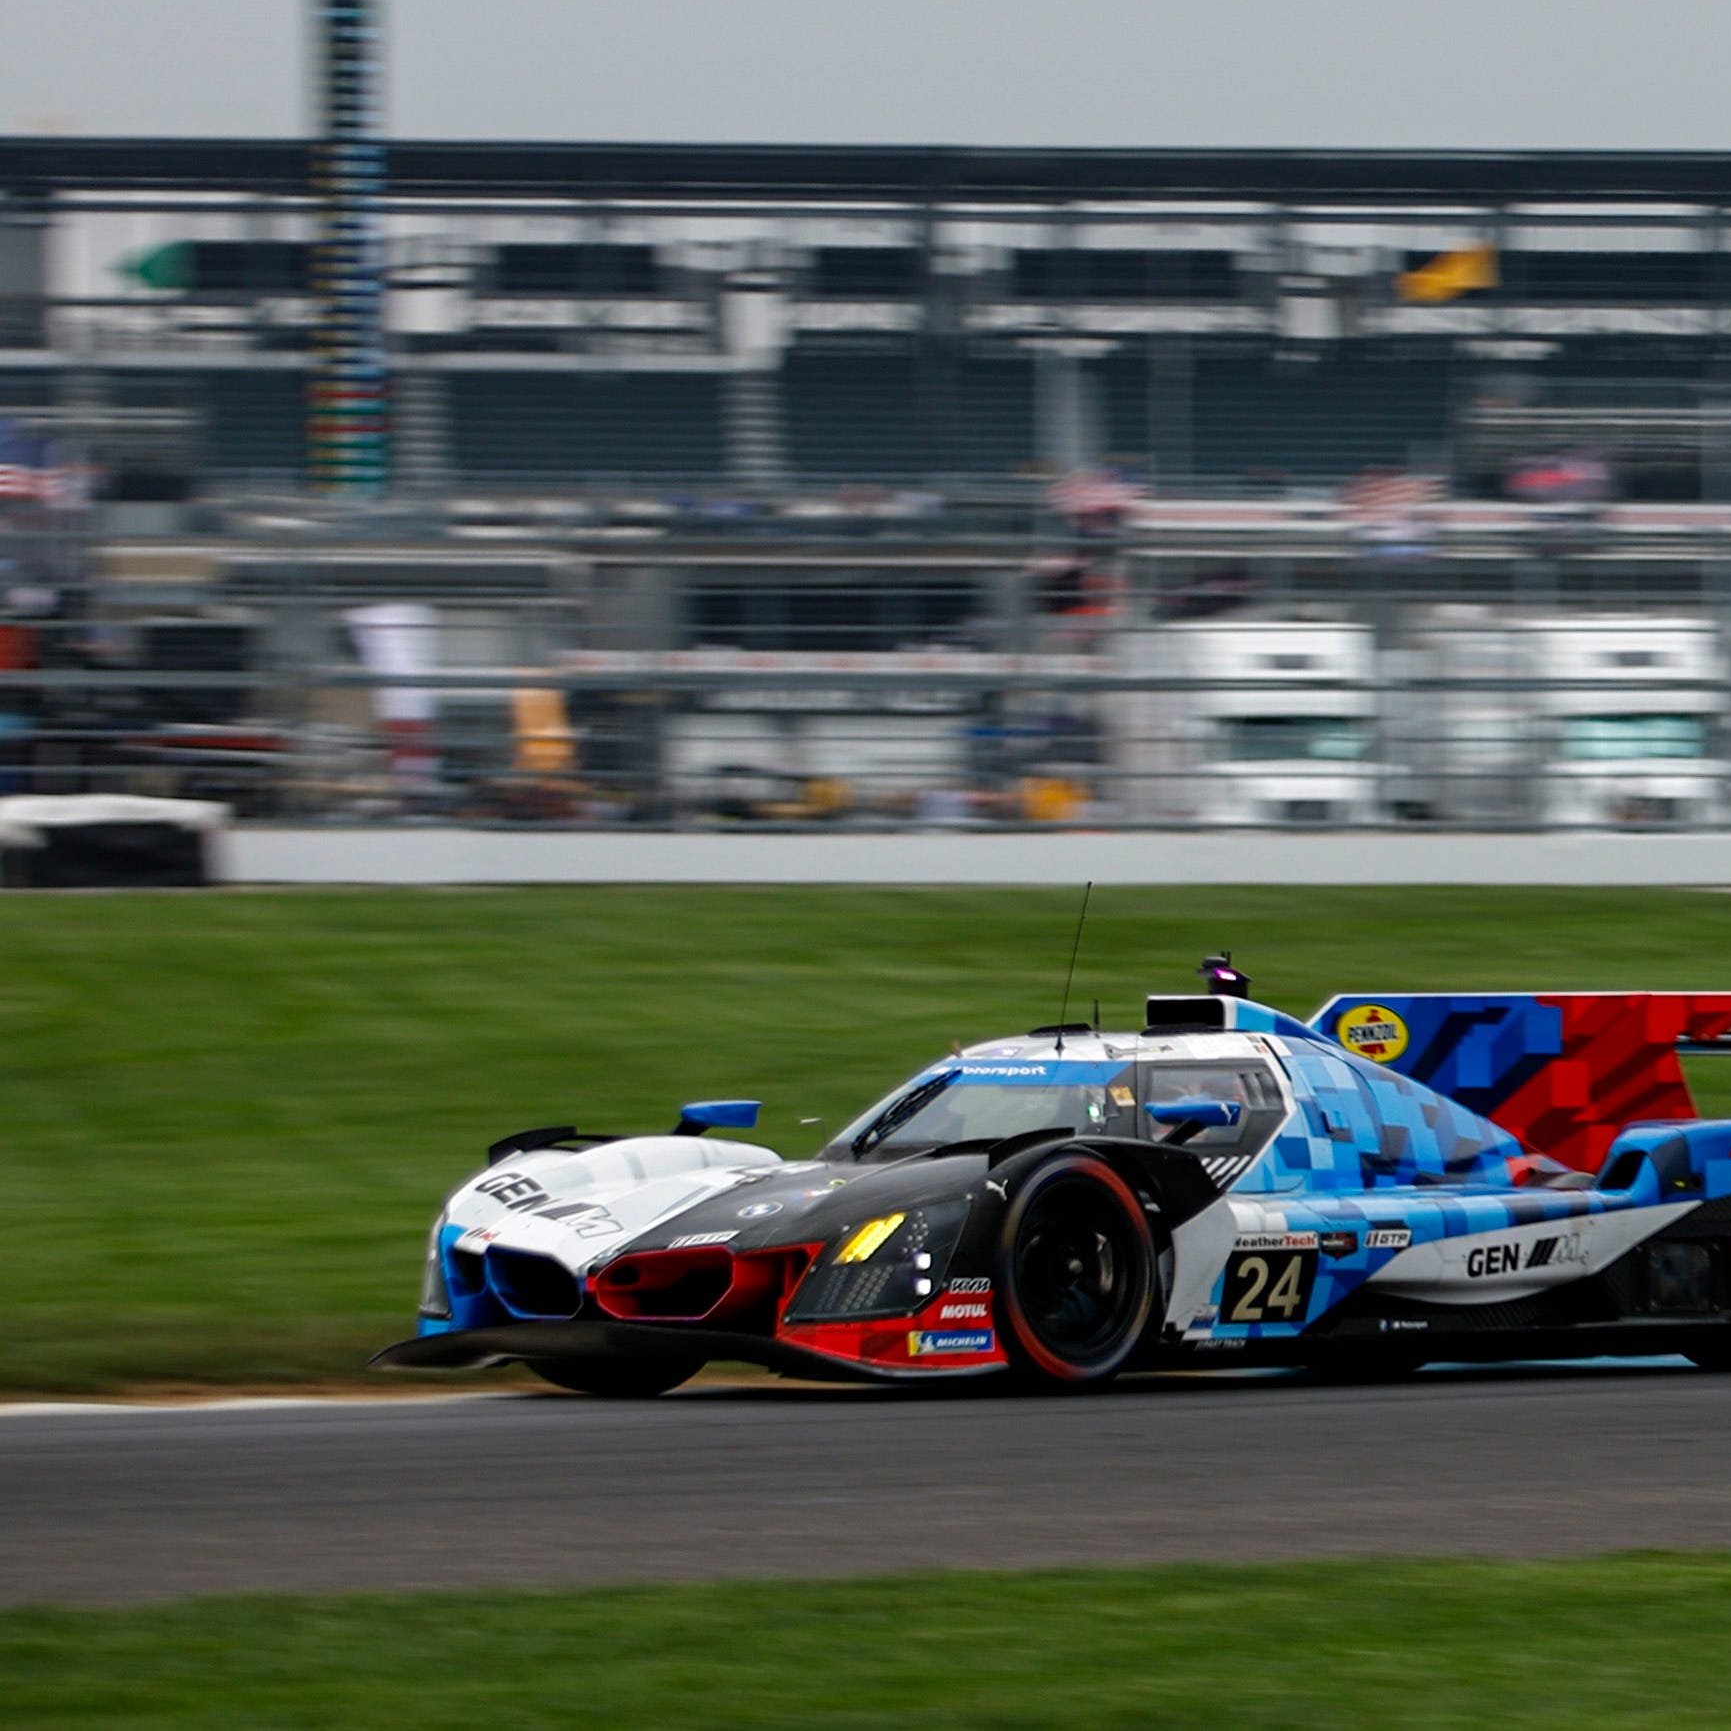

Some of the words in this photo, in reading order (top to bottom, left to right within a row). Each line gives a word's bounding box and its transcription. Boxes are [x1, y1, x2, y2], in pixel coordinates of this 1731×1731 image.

[1348, 1022, 1399, 1045] PENNZOIL
[955, 1065, 1047, 1076] otorsport
[475, 1172, 555, 1213] GEN
[1467, 1243, 1520, 1278] GEN
[1230, 1255, 1303, 1321] 24
[941, 1303, 987, 1320] MOTUL
[937, 1335, 988, 1348] MICHELIN
